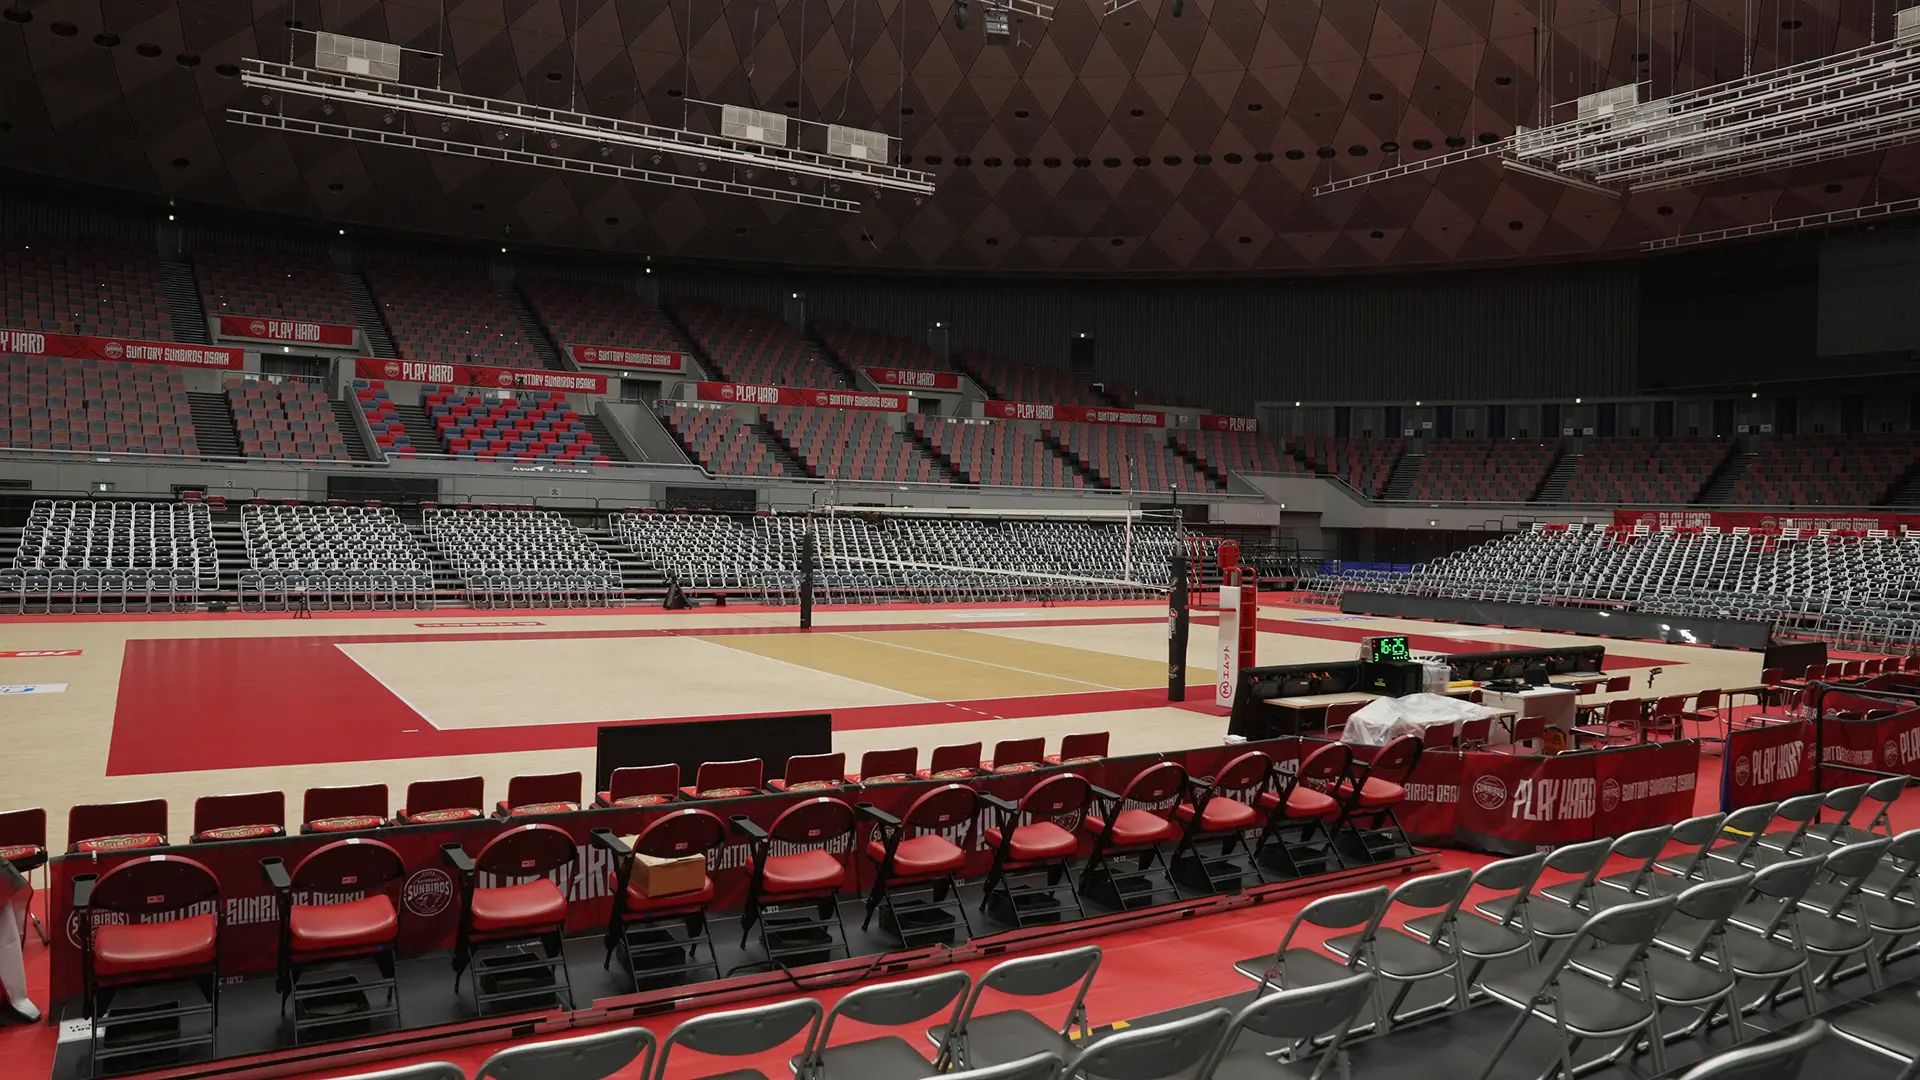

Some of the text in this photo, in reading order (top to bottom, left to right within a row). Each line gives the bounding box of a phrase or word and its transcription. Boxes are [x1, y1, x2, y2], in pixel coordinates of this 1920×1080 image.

[268, 321, 321, 340] PLAY HARD
[11, 332, 45, 354] HARD
[126, 345, 163, 360] SUNTORY
[164, 348, 203, 363] SUNBIRDS
[204, 351, 229, 365] OSAKA
[598, 350, 671, 366] SUNTORY SUNBIRDS OSAKA
[403, 362, 454, 383] PLAY HARD
[898, 371, 935, 387] PLAY HARD
[544, 375, 575, 388] SUNBIRDS
[576, 378, 596, 390] OSAKA
[736, 385, 779, 404] PLAY HARD
[1017, 404, 1054, 420] PLAY HARD
[1229, 417, 1245, 432] PLAY
[1659, 512, 1685, 527] PLAY
[1374, 653, 1379, 662] 3
[1752, 740, 1804, 787] PLAY HARD
[1512, 778, 1558, 821] PLAY
[1558, 777, 1597, 820] HARD
[407, 880, 450, 902] SUNBIRDS
